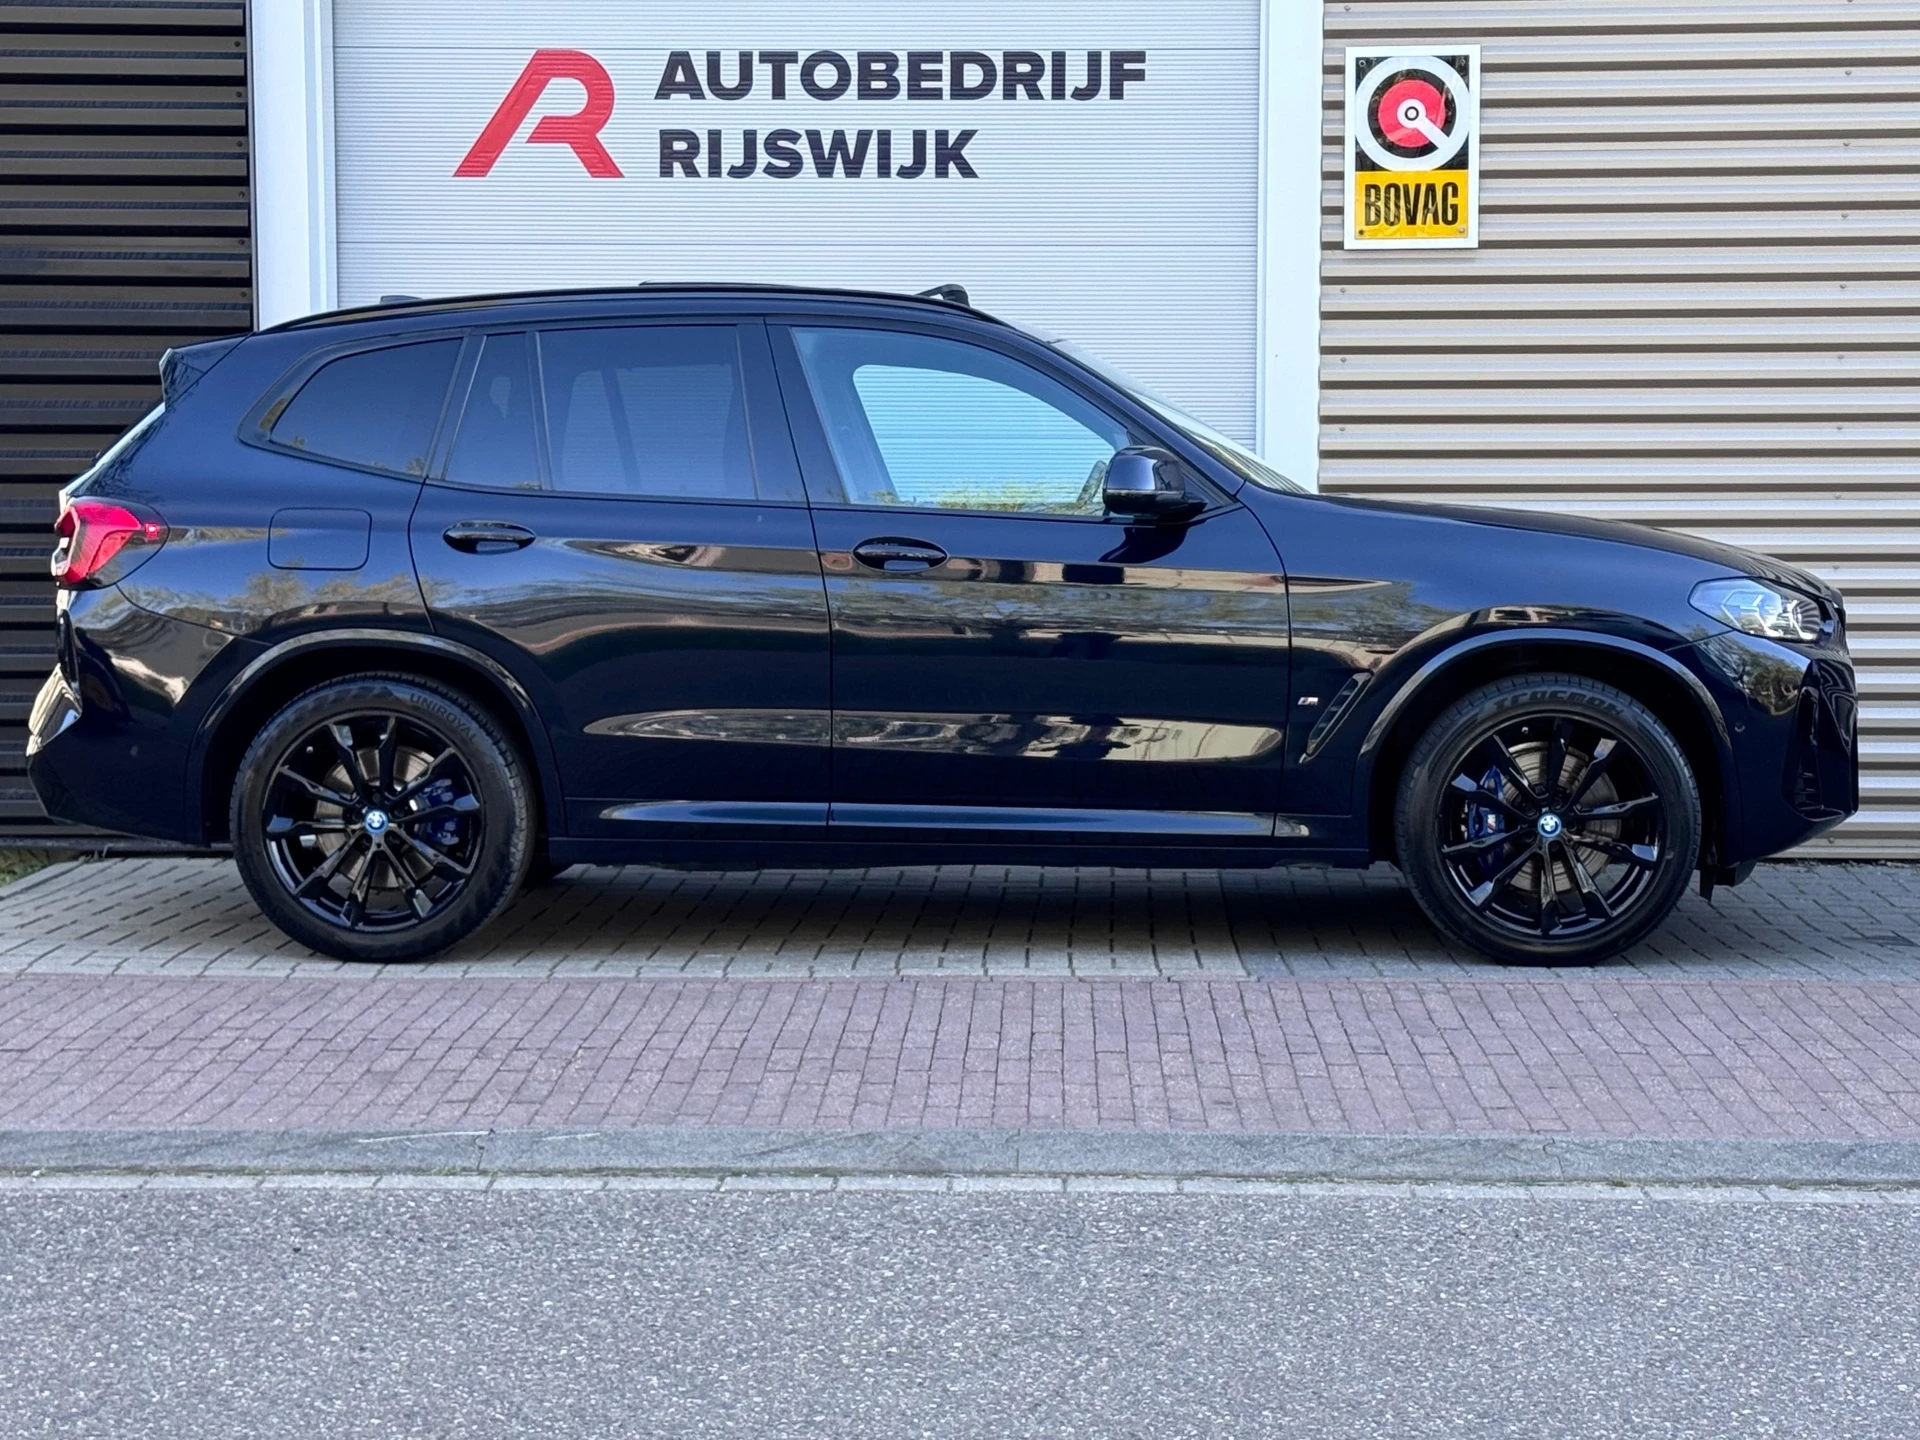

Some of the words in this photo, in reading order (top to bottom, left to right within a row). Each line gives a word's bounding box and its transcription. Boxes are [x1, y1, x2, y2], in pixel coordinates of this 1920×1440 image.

[654, 51, 1147, 101] AUTOBEDRIJF
[659, 129, 978, 178] RIJSWIJK
[1364, 181, 1459, 226] BOVAG
[410, 693, 477, 744] UNIROYAL
